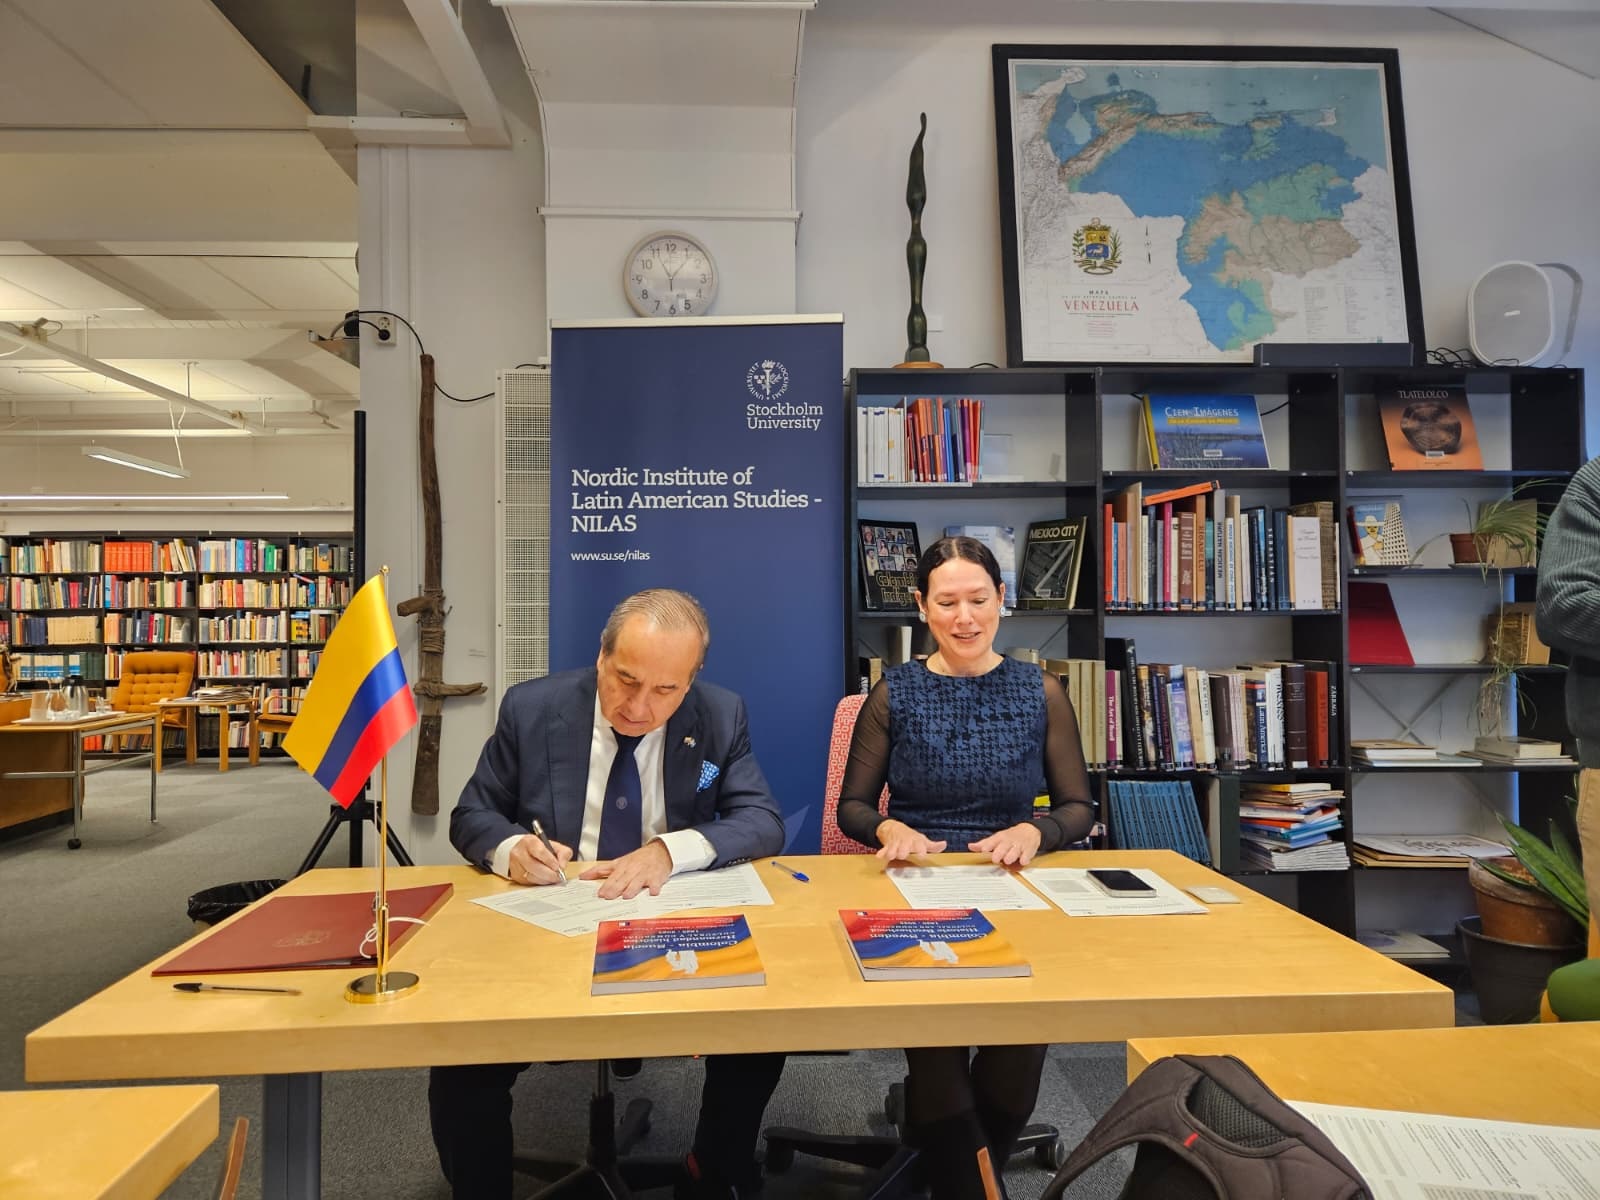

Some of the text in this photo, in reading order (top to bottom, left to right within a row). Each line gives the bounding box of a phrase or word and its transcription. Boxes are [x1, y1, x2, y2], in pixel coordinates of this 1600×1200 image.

[651, 247, 661, 258] 11
[664, 243, 677, 253] 12
[641, 258, 653, 270] 10
[635, 274, 643, 285] 9
[700, 274, 707, 284] 3
[641, 289, 649, 300] 8
[696, 288, 702, 299] 4
[654, 300, 661, 311] 7
[669, 304, 677, 315] 6
[684, 299, 691, 310] 5
[1064, 300, 1140, 311] VENEZUELA
[1398, 390, 1449, 399] TLATELOLCO
[746, 402, 823, 416] Stockholm
[747, 415, 821, 431] University
[571, 465, 755, 487] Nordic Institute of
[571, 490, 623, 510] Latin
[627, 489, 729, 509] American
[733, 488, 809, 509] Studies
[571, 514, 637, 533] NILAS
[1029, 525, 1079, 540] MEXICO CITY
[570, 550, 651, 562] www.su.se/nilas
[1260, 726, 1268, 754] America
[678, 940, 738, 949] Colombia
